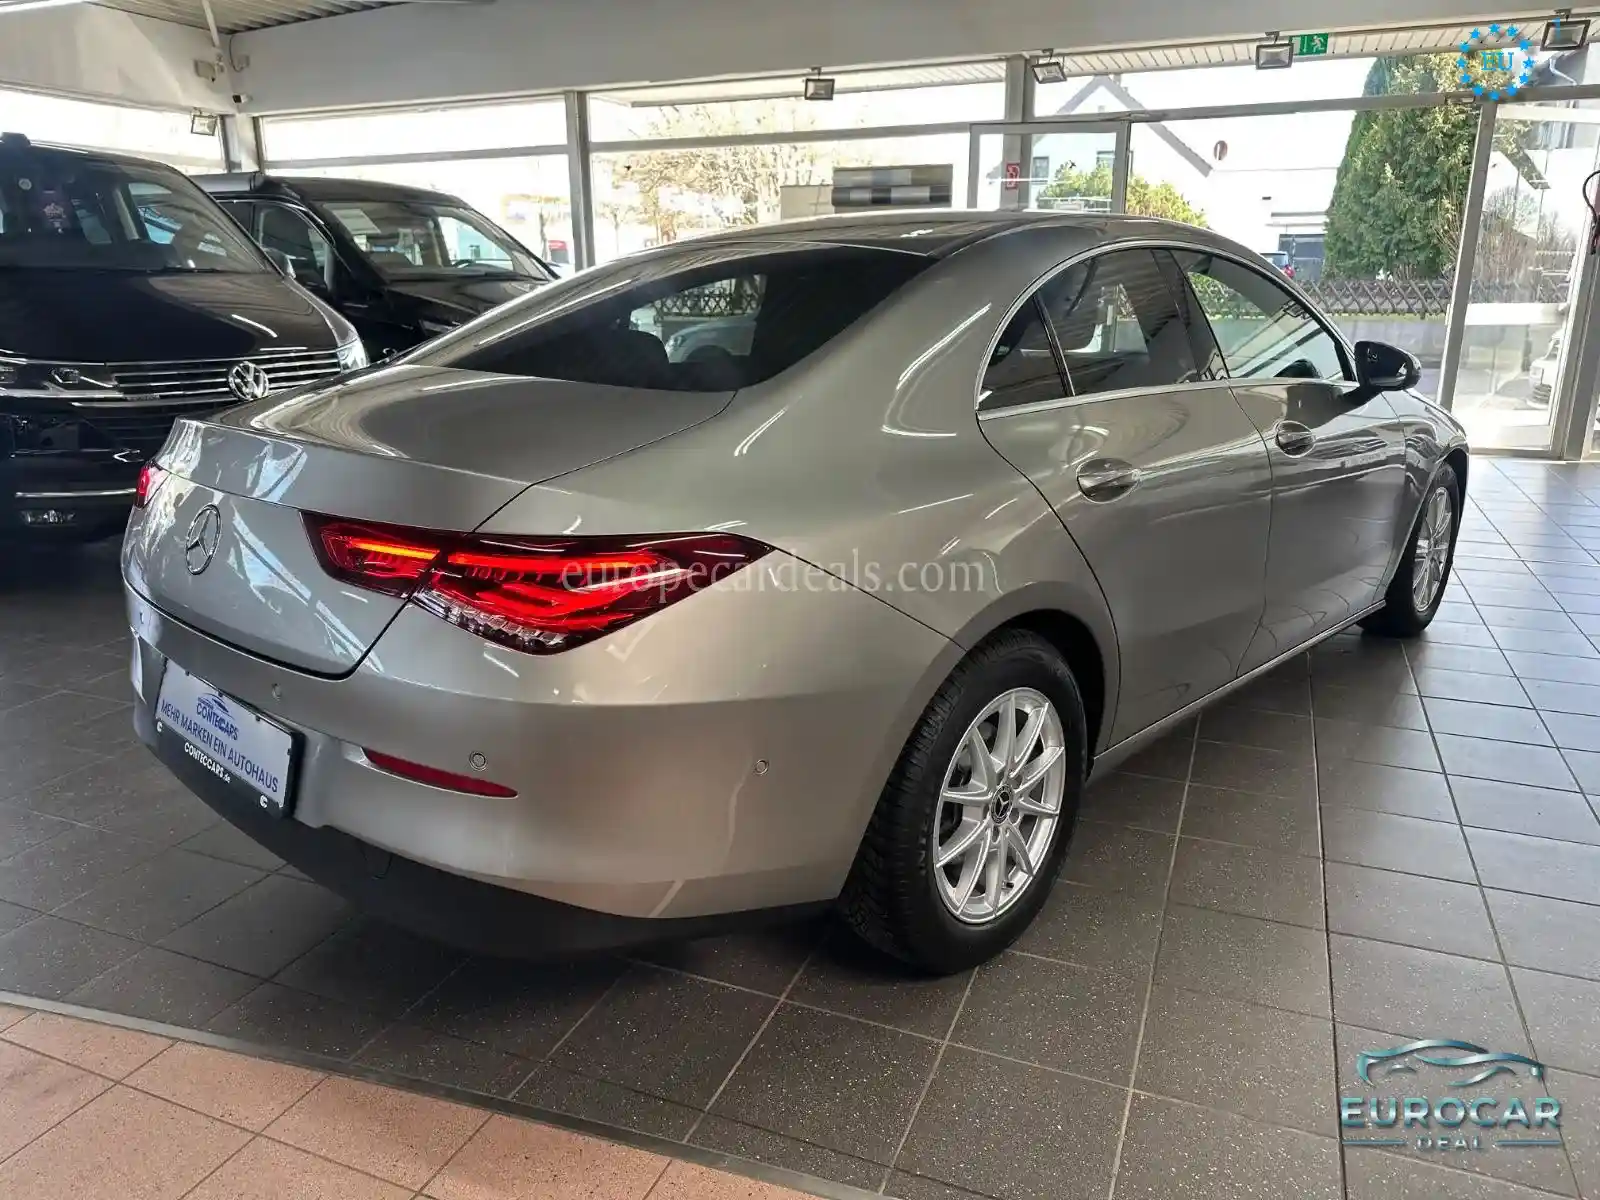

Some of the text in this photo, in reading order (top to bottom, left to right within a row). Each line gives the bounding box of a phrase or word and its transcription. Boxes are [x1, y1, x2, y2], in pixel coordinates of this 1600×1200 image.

[161, 699, 279, 793] MEHR MARKEN EIN AUTOHAUS
[184, 742, 231, 784] CONTECCARS.de
